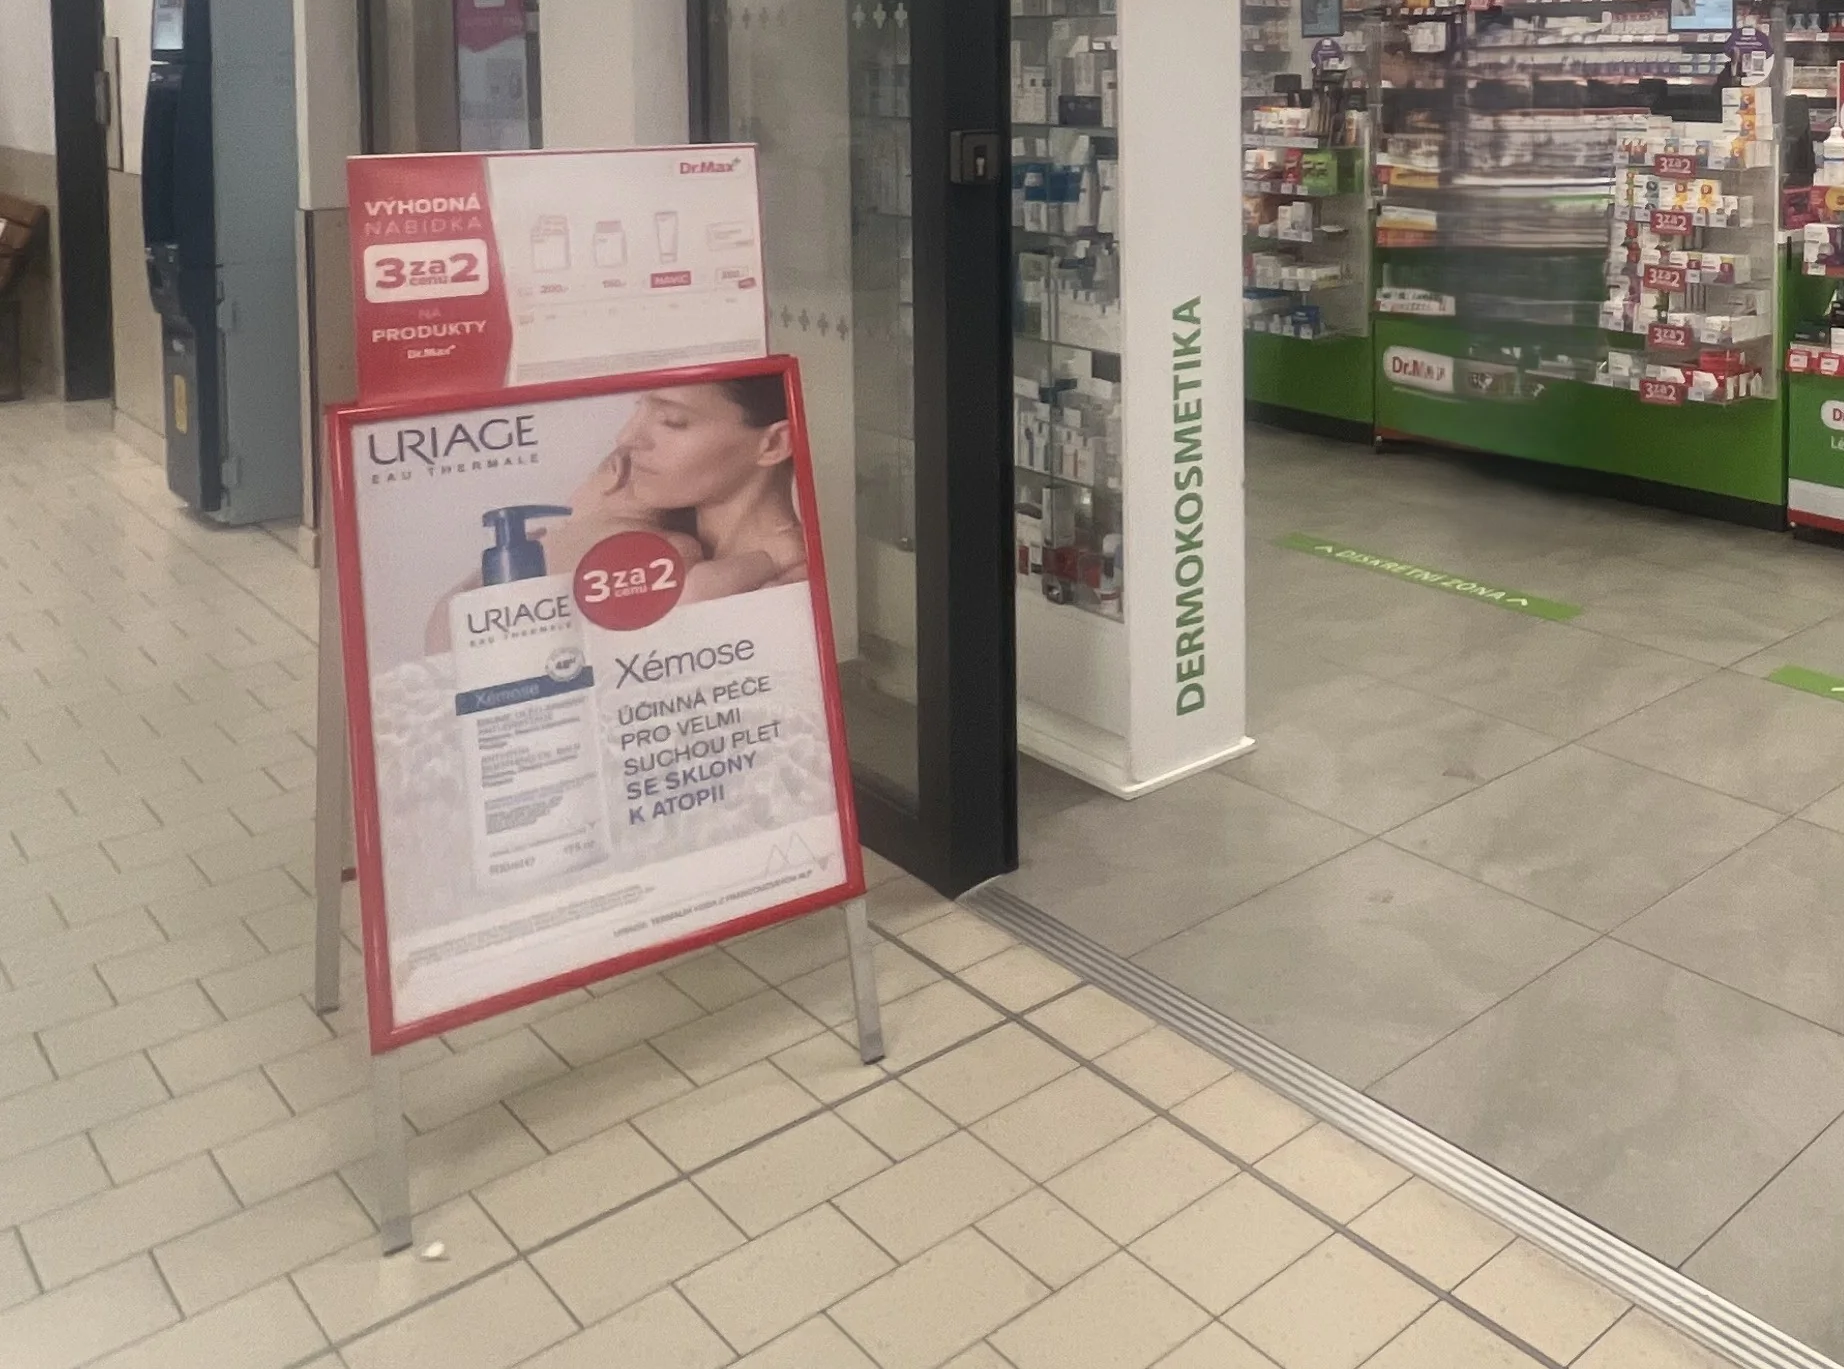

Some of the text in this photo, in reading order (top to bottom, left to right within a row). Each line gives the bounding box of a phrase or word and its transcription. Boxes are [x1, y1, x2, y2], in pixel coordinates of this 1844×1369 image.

[679, 161, 734, 175] Dr.Max
[364, 192, 482, 217] VÝHODNÁ
[371, 319, 487, 344] PRODUKTY
[367, 414, 539, 466] URIAGE
[371, 453, 540, 485] EAU THERMALE
[1172, 295, 1206, 717] DERMOKOSMETIKA
[467, 594, 572, 634] URIAGE
[614, 638, 756, 690] Xémose
[617, 675, 772, 727] ÚČINNÁ PÉČE
[620, 707, 742, 751] PRO VELMI
[624, 735, 726, 776] SUCHOU
[626, 750, 758, 801] SE SKLONY
[628, 784, 726, 826] K ATOPII
